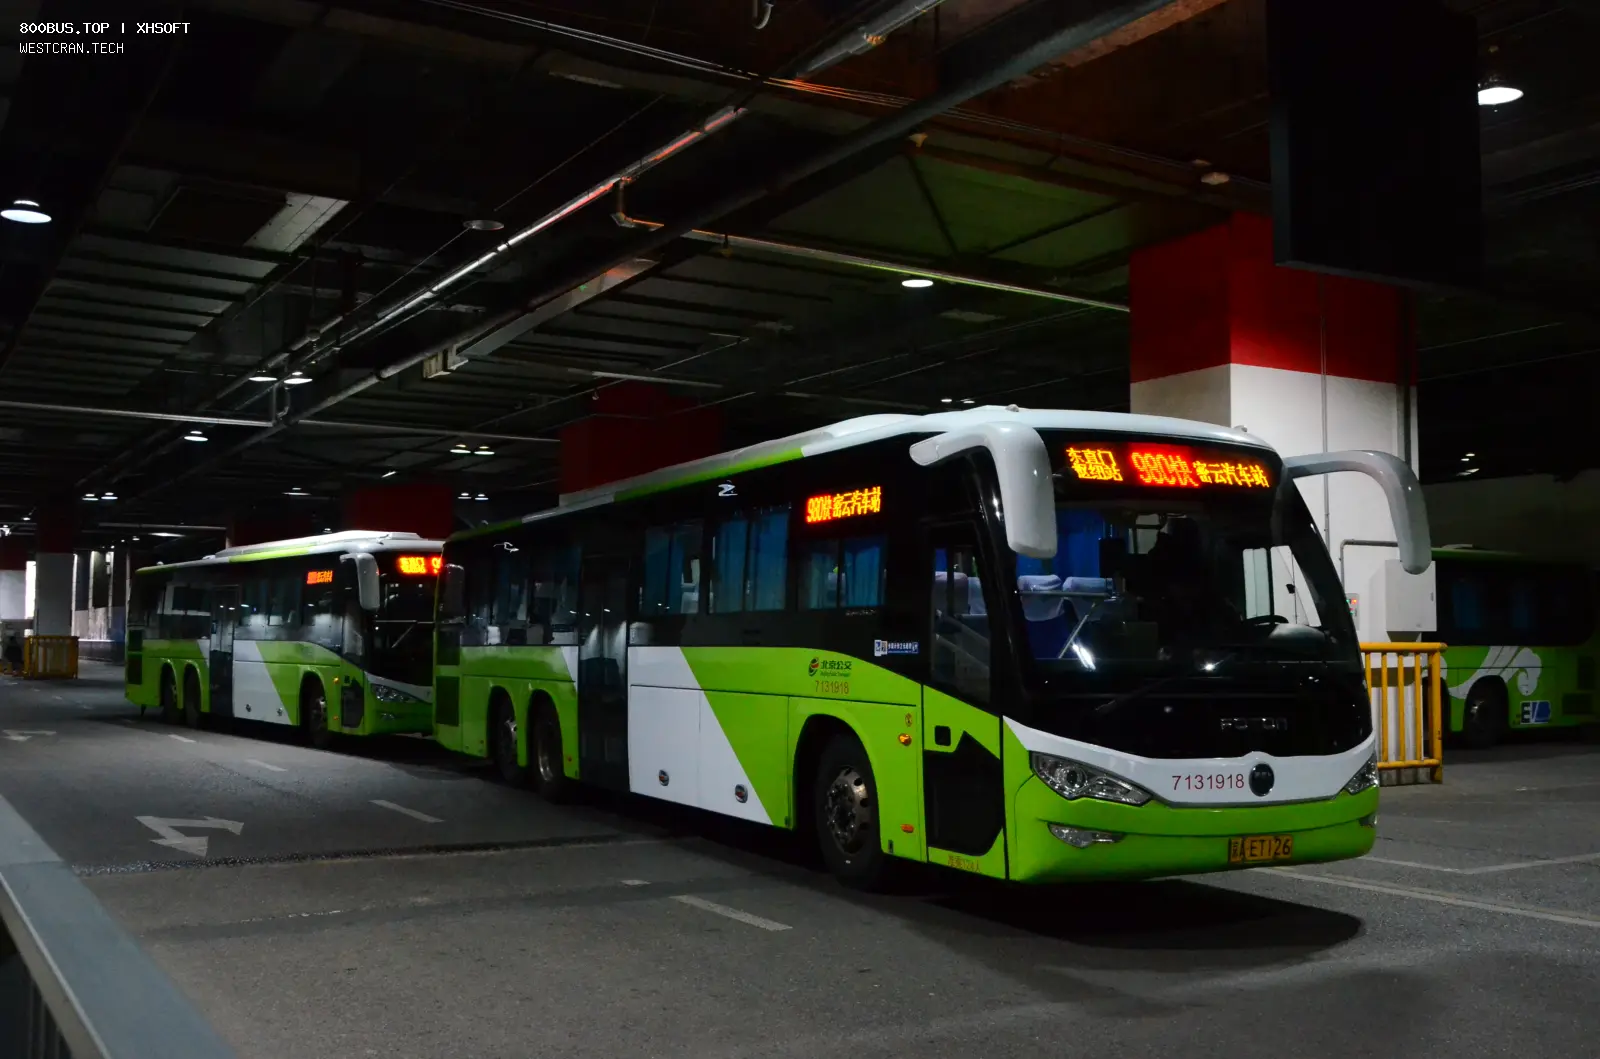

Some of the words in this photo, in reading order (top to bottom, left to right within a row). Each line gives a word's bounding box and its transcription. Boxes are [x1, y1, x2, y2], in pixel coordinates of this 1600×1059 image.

[1066, 448, 1117, 467] 东直门
[820, 660, 852, 670] 北京公交
[815, 680, 850, 694] 7131918
[1172, 773, 1245, 790] 7131918
